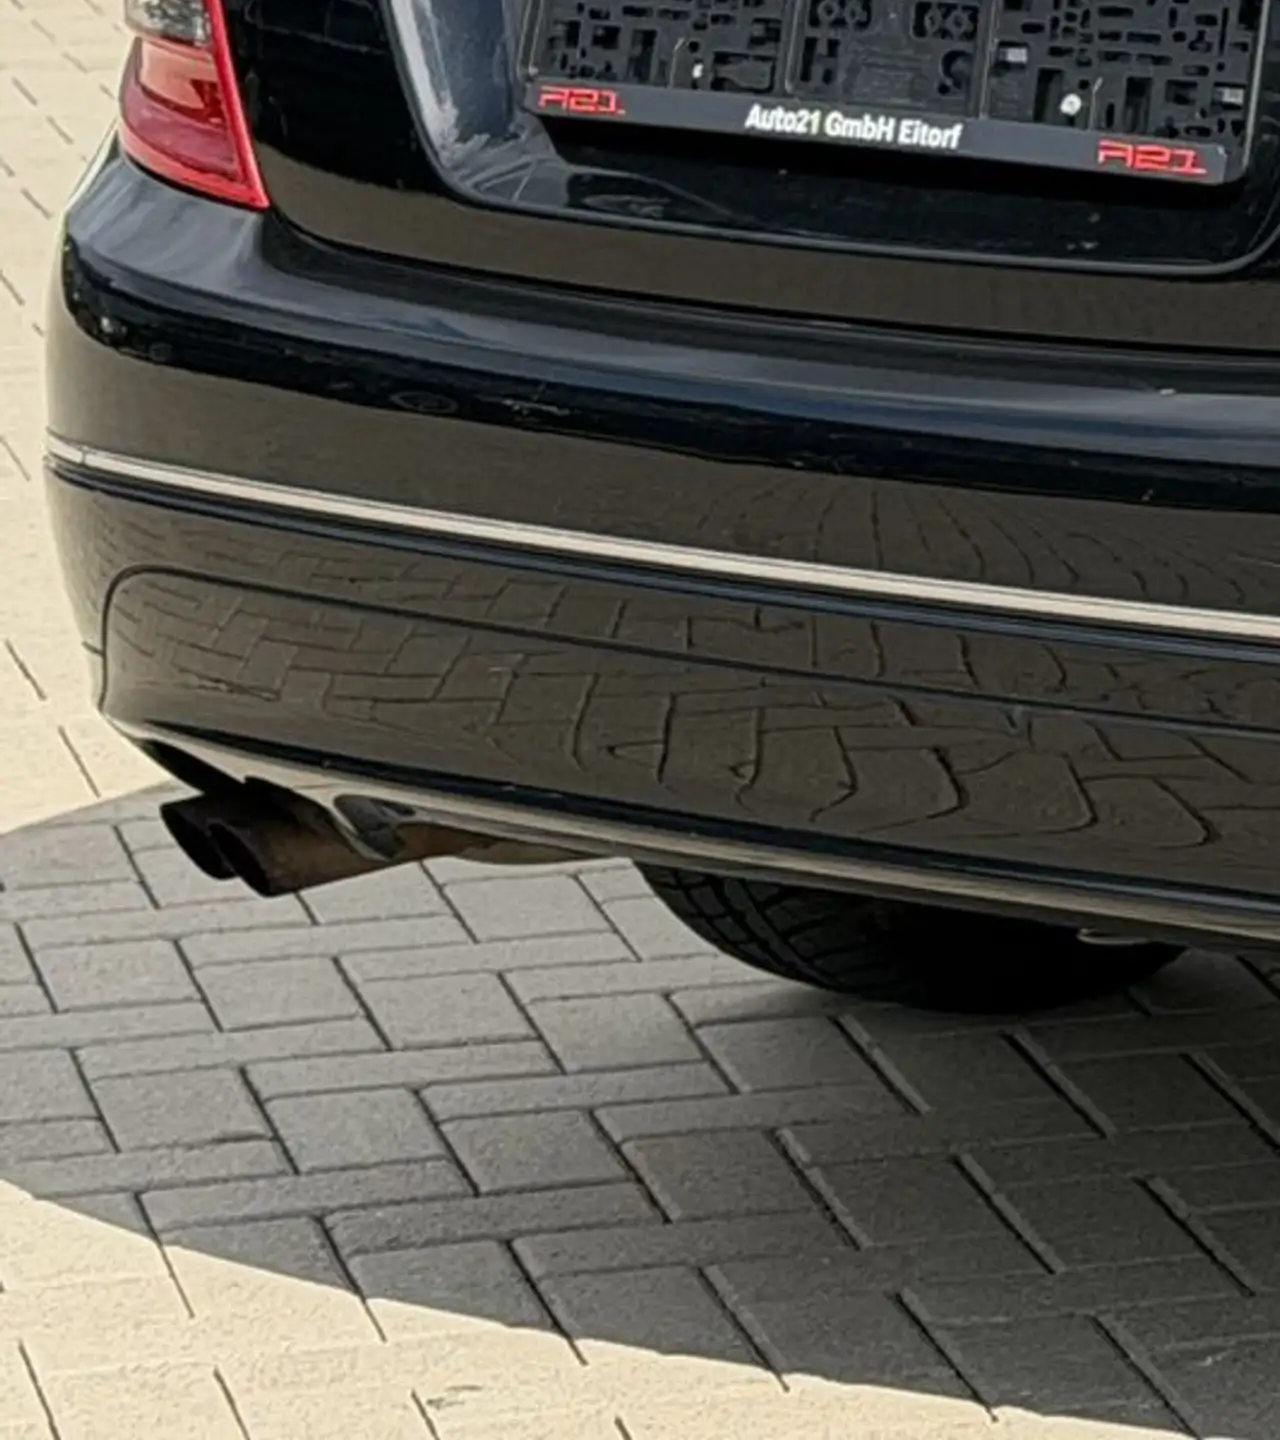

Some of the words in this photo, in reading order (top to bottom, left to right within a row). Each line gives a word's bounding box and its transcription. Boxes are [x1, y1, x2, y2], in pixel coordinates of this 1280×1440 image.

[744, 102, 822, 136] Auto21
[824, 110, 896, 143] GmbH
[898, 119, 964, 150] Eitorf
